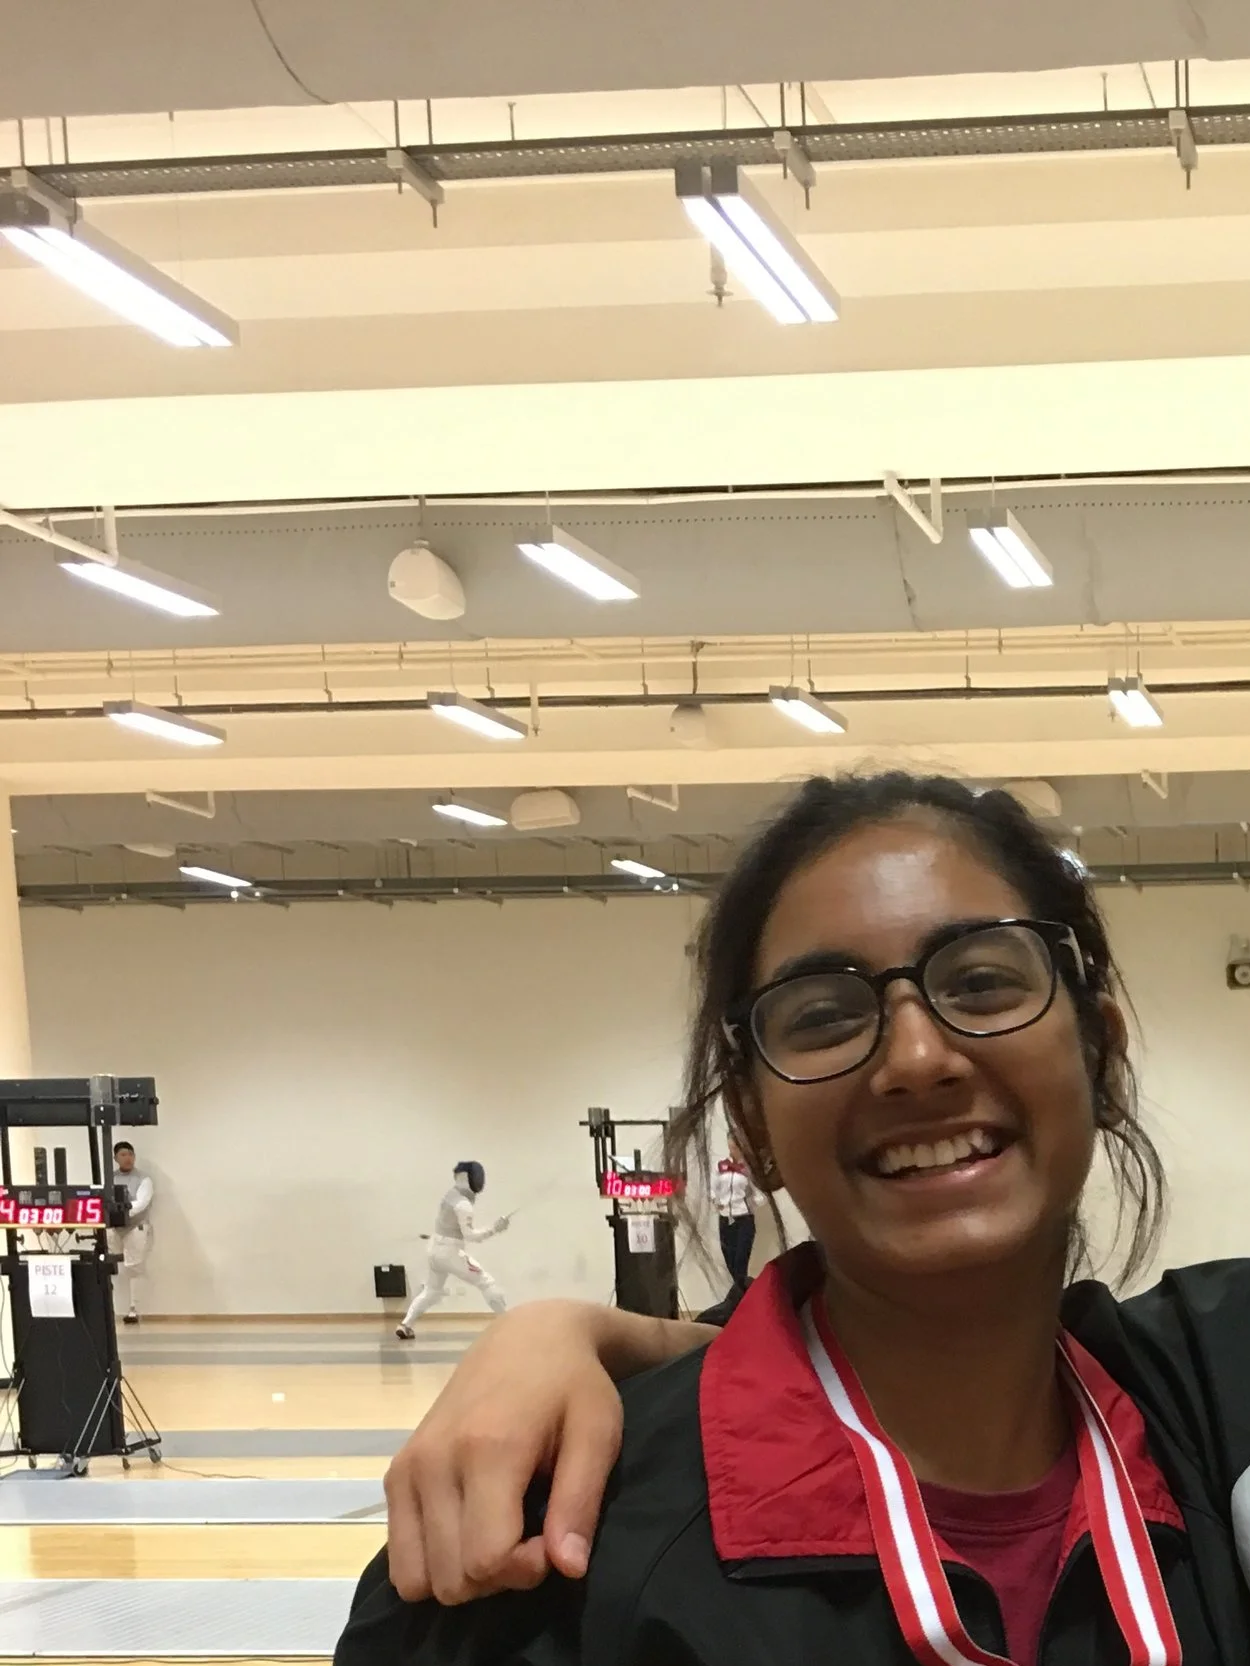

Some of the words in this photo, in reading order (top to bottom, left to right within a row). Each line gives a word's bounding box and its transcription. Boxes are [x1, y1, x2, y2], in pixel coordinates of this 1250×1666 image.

[76, 1198, 102, 1223] 15
[35, 1264, 65, 1276] PISTE
[44, 1283, 57, 1295] 12
